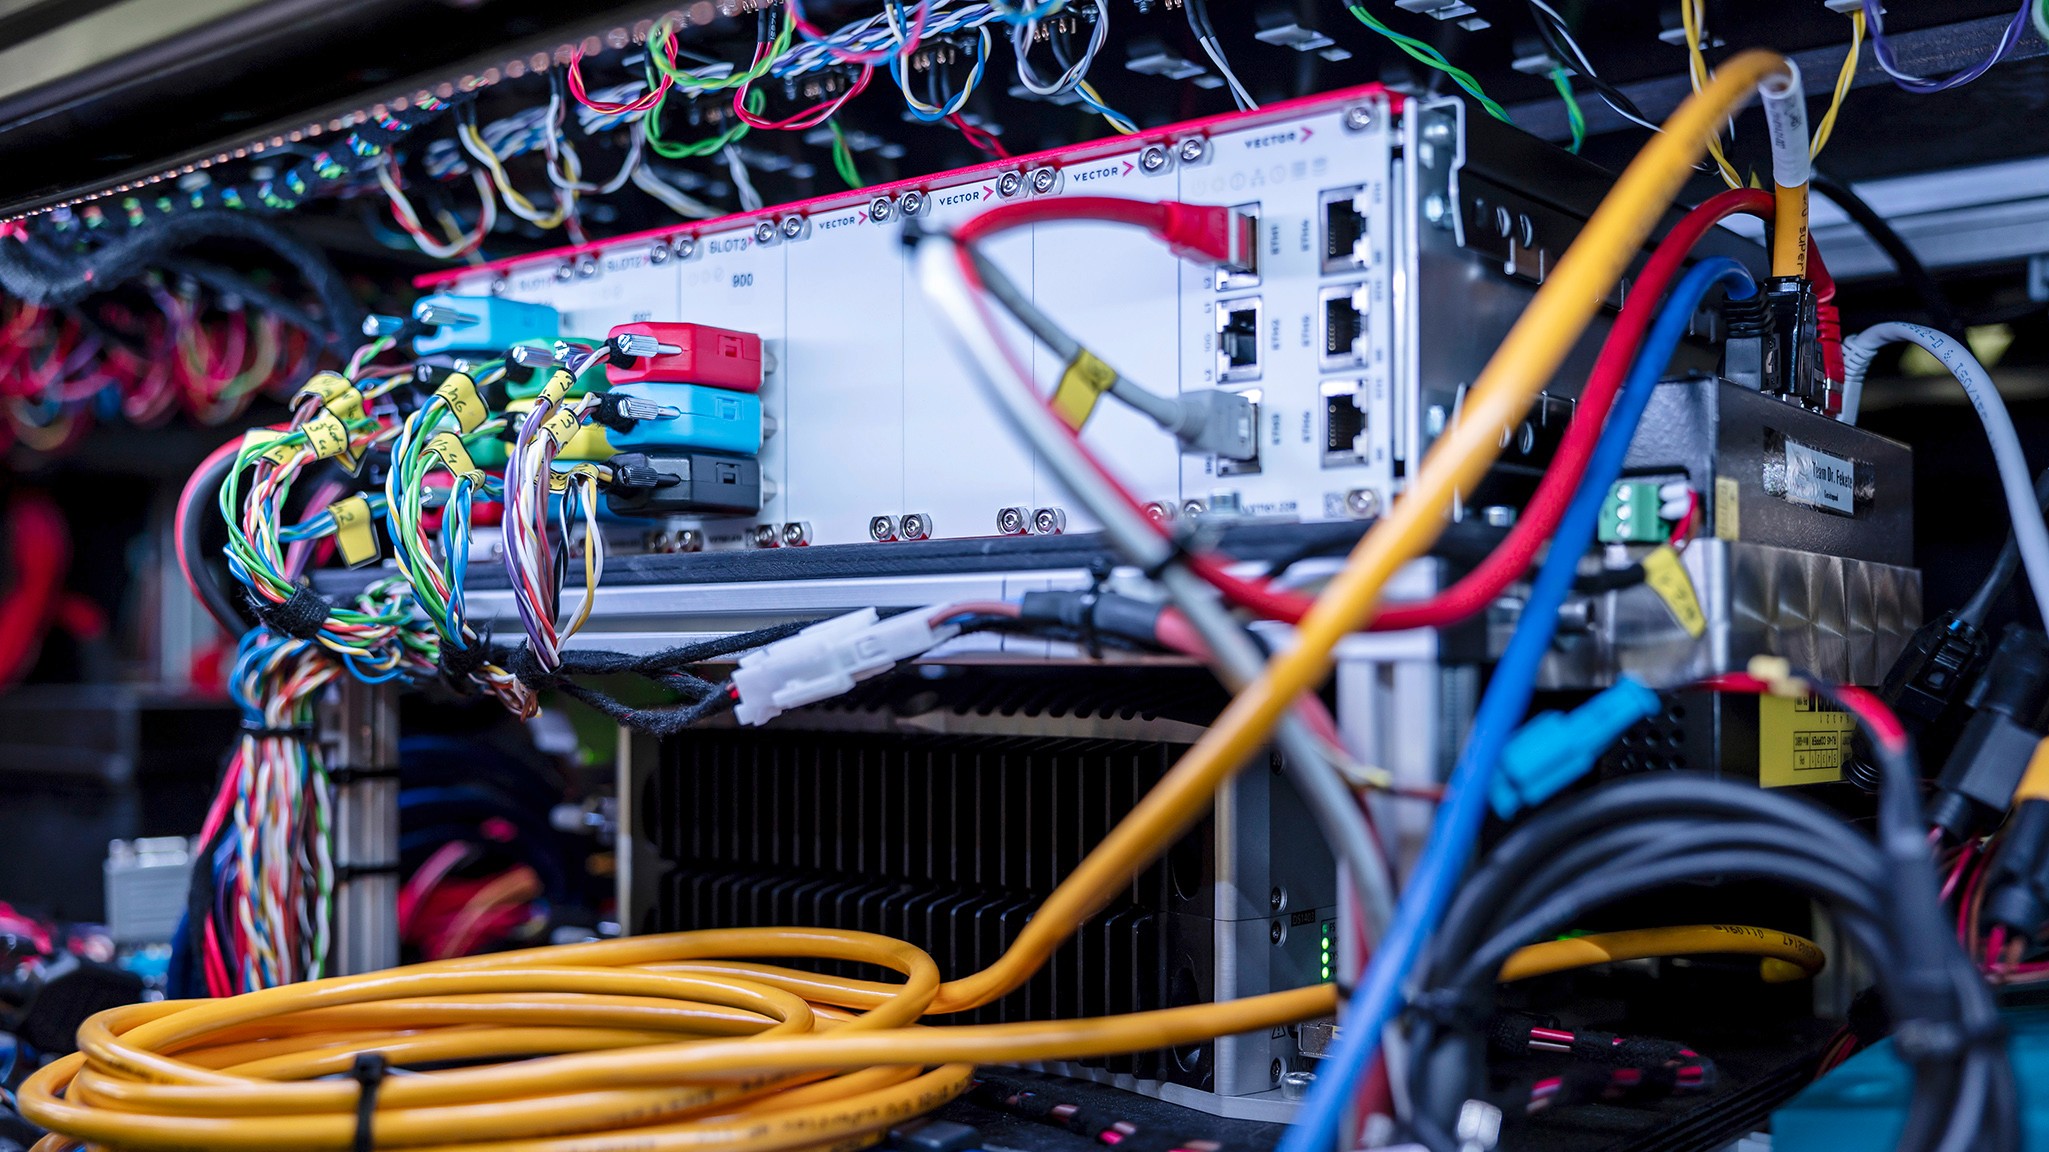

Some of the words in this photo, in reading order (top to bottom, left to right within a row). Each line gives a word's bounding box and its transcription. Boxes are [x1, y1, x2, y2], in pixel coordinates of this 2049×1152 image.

[1245, 132, 1296, 149] VECTOR
[1073, 167, 1119, 183] VECTOR
[938, 190, 980, 206] VECTOR
[818, 216, 856, 230] VECTOR
[709, 238, 748, 255] SLOT3
[1812, 461, 1827, 481] Team
[1827, 466, 1836, 484] Dr.
[1836, 469, 1853, 490] Fekete
